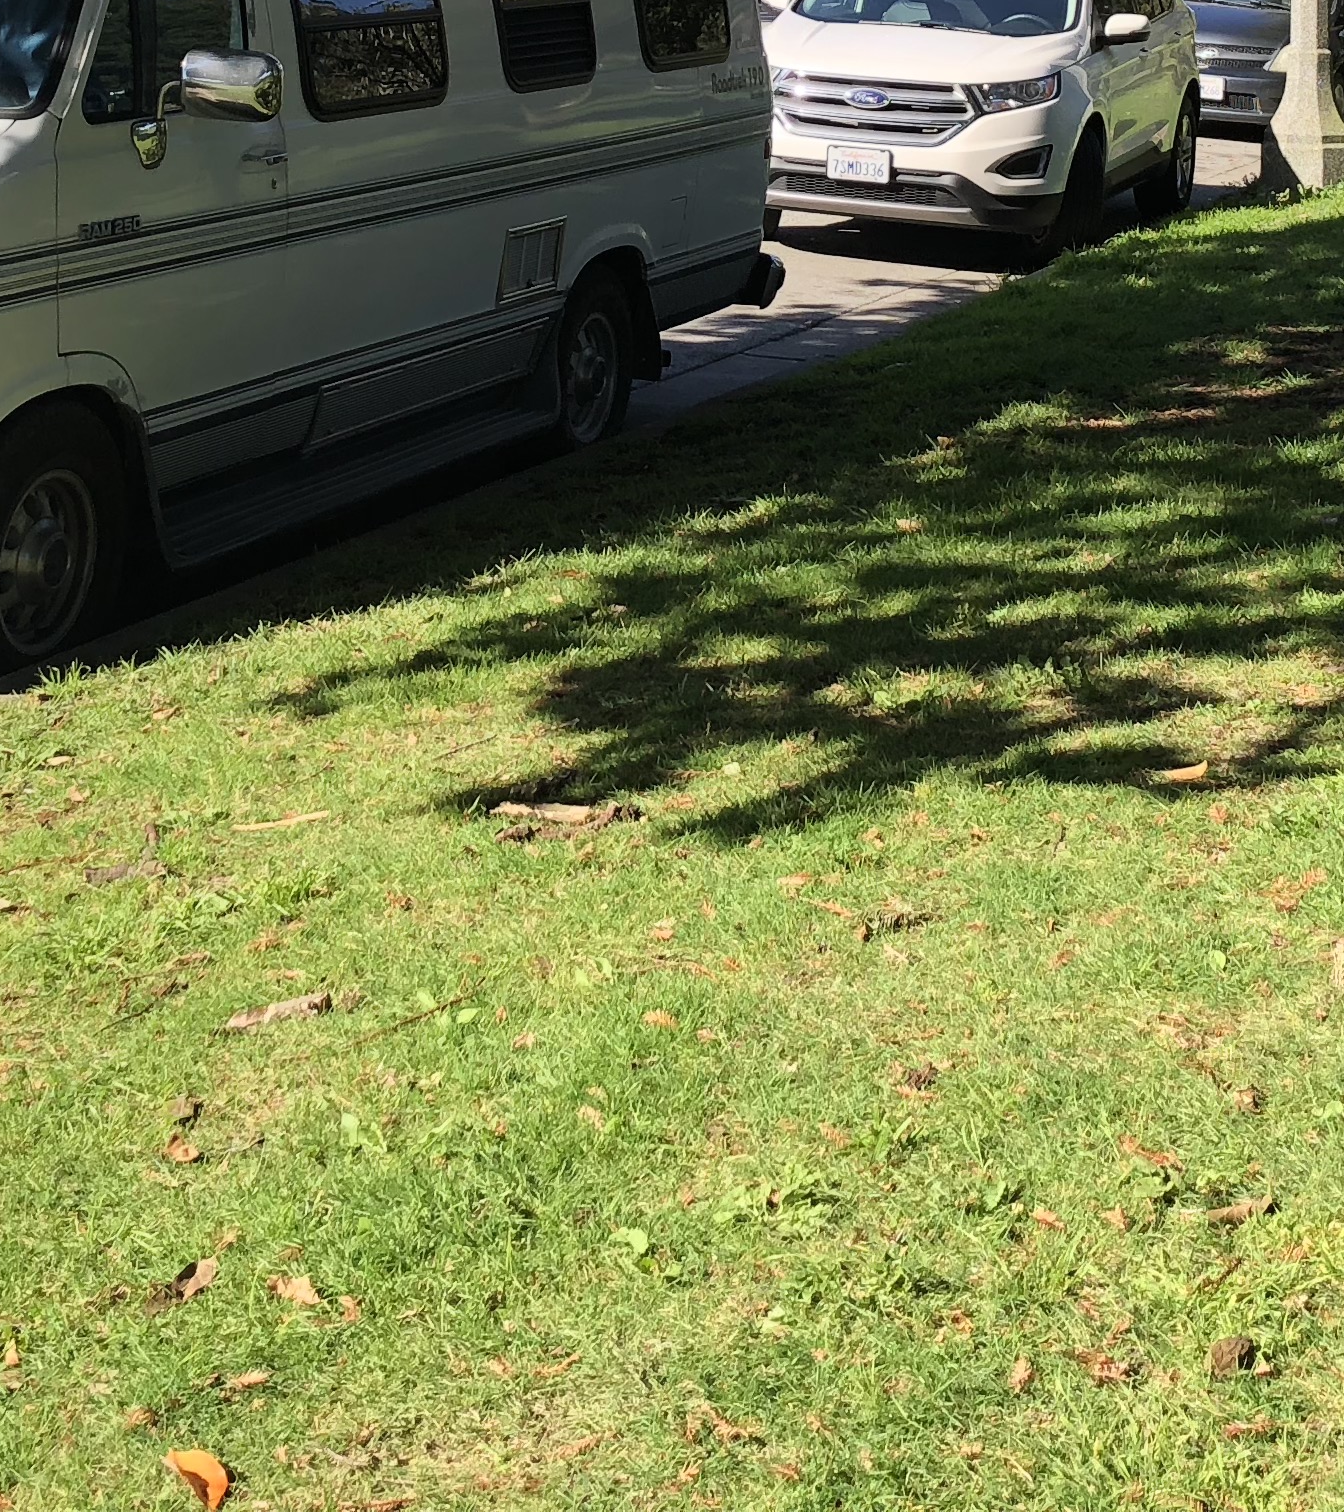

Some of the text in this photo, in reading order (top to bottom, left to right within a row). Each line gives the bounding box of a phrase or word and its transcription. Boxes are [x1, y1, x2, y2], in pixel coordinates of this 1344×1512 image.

[747, 66, 764, 88] 190
[832, 159, 884, 178] 7SMD336
[79, 216, 143, 241] RAM 250
